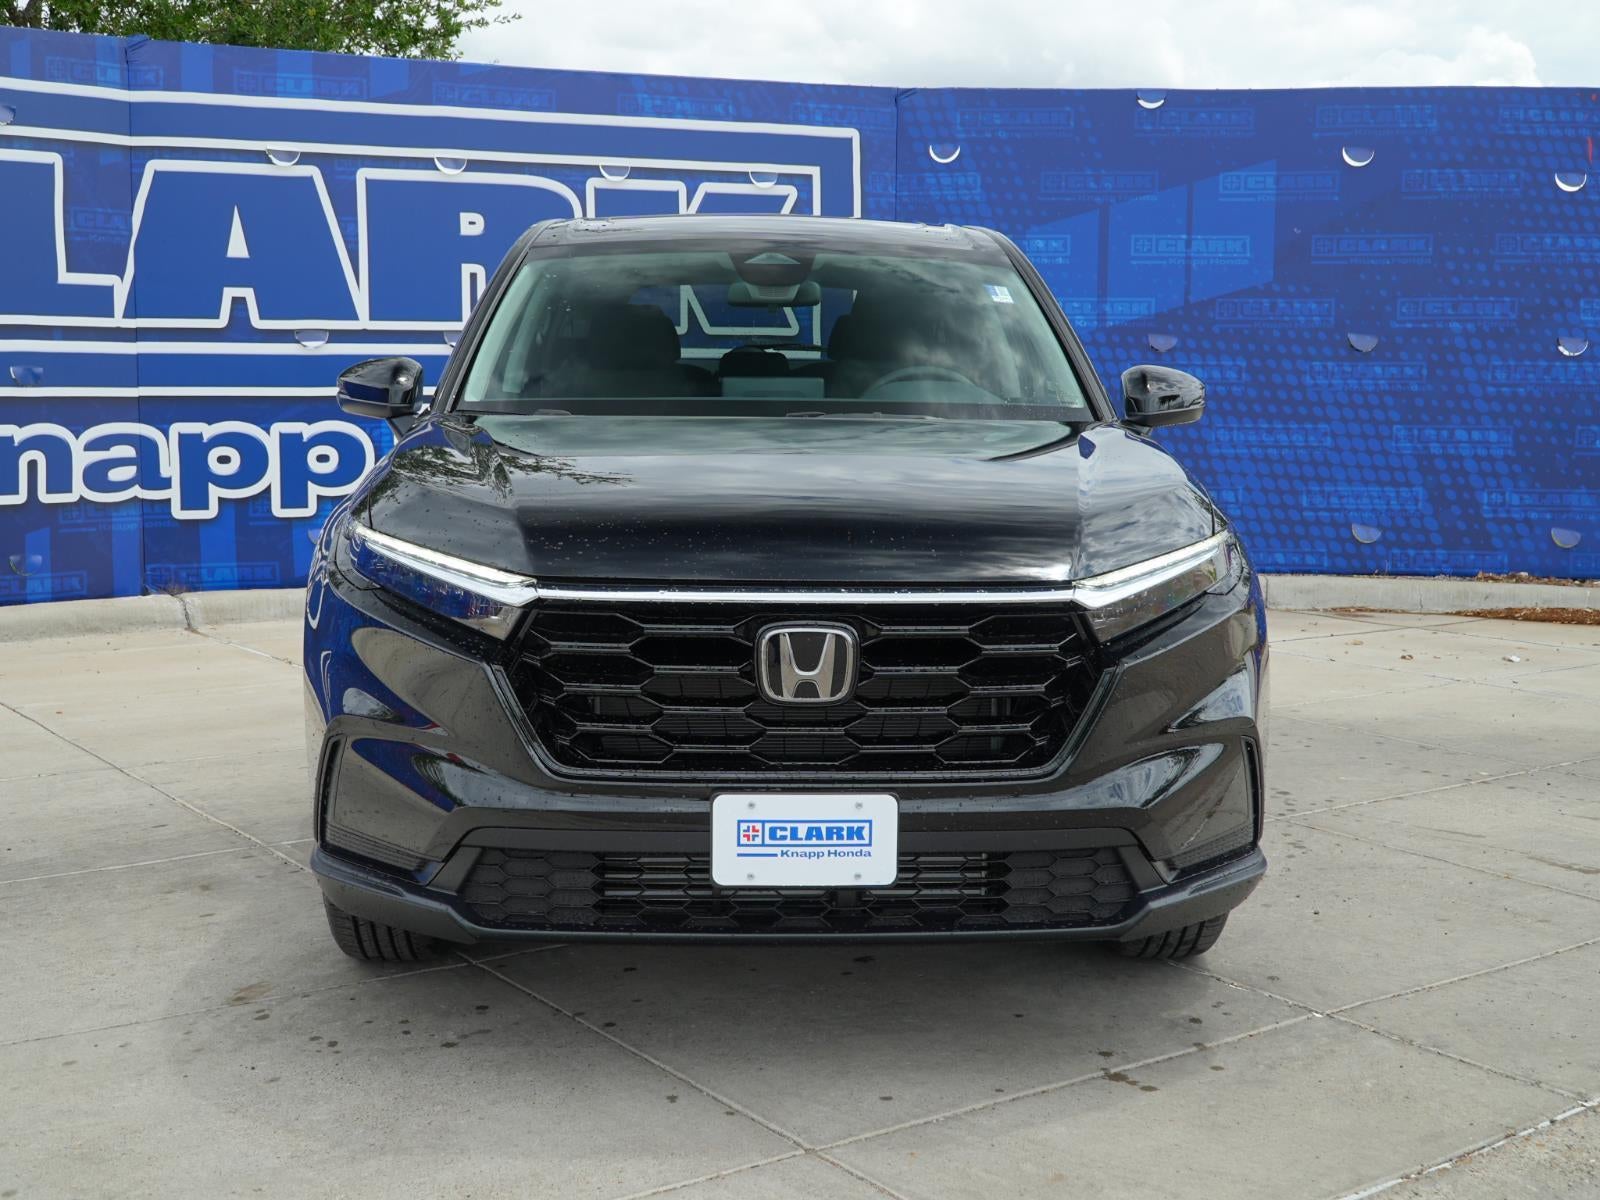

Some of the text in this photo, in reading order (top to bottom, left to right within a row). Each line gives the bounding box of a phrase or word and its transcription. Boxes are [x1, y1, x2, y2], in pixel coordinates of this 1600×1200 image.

[1158, 239, 1245, 252] CLARK
[768, 825, 865, 841] CLARK
[780, 849, 872, 859] Knapp Honda
